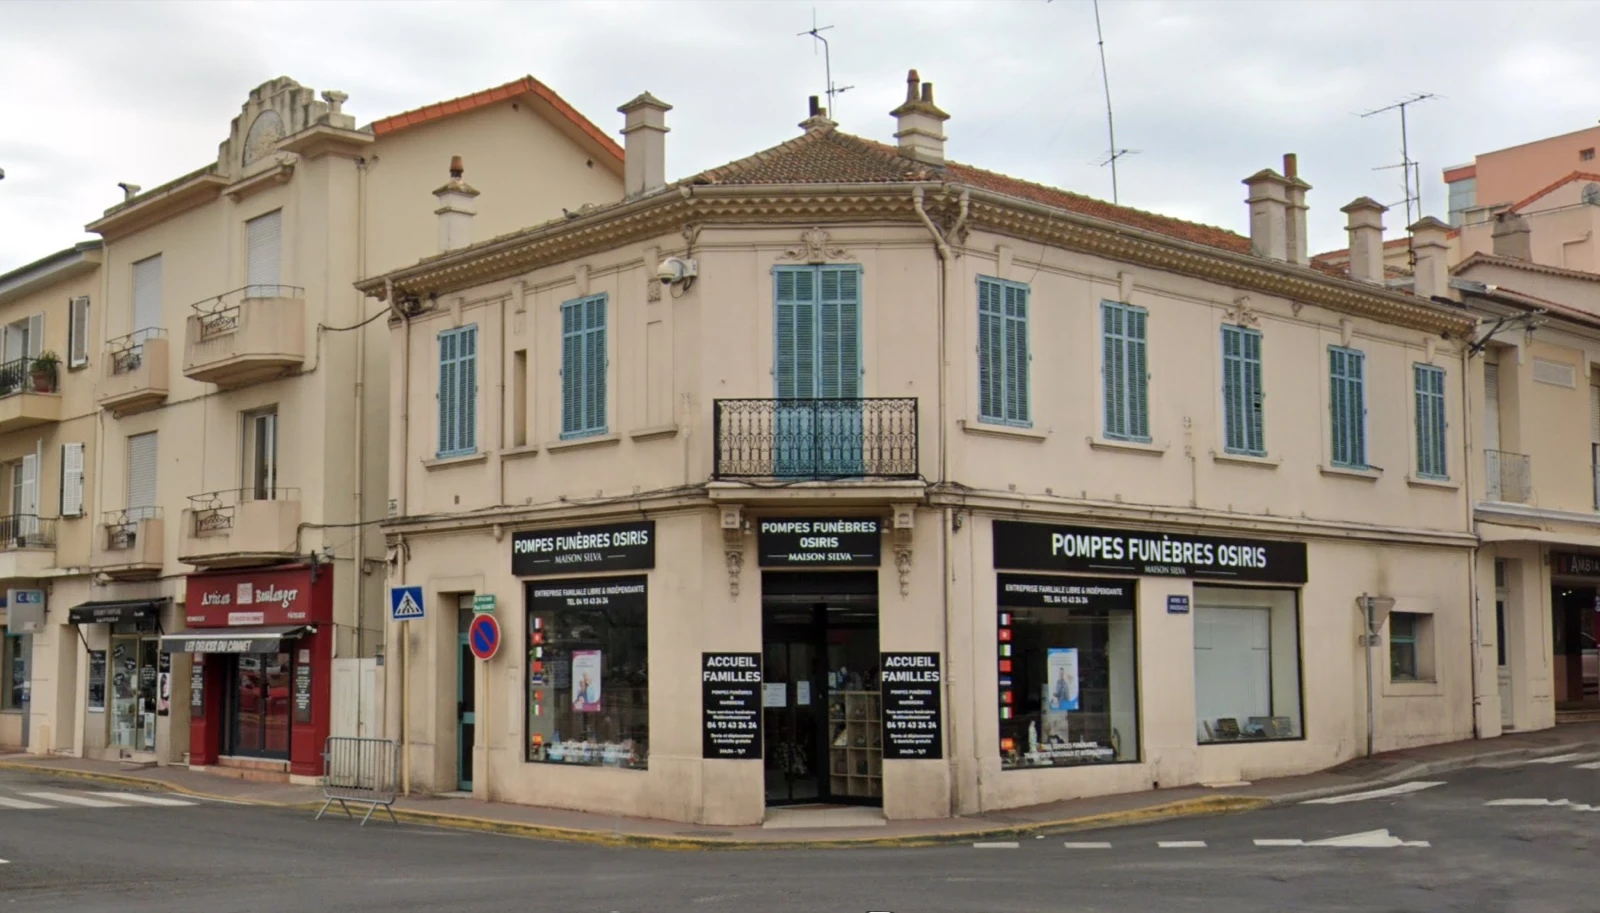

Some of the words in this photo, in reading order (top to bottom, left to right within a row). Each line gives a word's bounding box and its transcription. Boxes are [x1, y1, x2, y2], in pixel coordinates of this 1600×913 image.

[761, 522, 810, 533] POMPES
[813, 519, 877, 533] FUNÈBRES
[514, 537, 554, 554] POMPES
[556, 531, 610, 551] FUNÈBRES
[613, 530, 648, 547] OSIRIS
[800, 537, 839, 548] OSIRIS
[788, 552, 826, 561] MAISON
[827, 552, 852, 561] SILVA
[1052, 533, 1124, 560] POMPES
[1128, 535, 1213, 565] FUNÈBRES
[1218, 545, 1267, 568] OSIRIS
[554, 553, 582, 564] MAISON
[583, 552, 602, 562] SILVA
[1144, 565, 1170, 575] MAISON
[1170, 566, 1186, 576] SILVA
[255, 584, 298, 608] Boulanger
[534, 588, 562, 598] ENTREPRISE
[562, 587, 587, 597] FAMILIALE
[587, 586, 602, 596] LIBRE
[602, 586, 606, 595] &
[606, 584, 645, 595] INDÉPENDANTE
[1005, 584, 1038, 593] ENTREPRISE
[1039, 585, 1065, 594] FAMILIALE
[1066, 586, 1081, 595] LIBRE
[1081, 587, 1086, 595] &
[1086, 586, 1123, 596] INDÉPENDANTE
[17, 593, 37, 602] CIC
[201, 591, 231, 606] Artisan
[184, 640, 196, 652] LES
[217, 640, 226, 652] DU
[226, 640, 252, 652] CANNET
[707, 657, 757, 667] ACCUEIL
[885, 657, 935, 667] ACCUEIL
[703, 671, 761, 682] FAMILLES
[882, 671, 940, 682] FAMILLES
